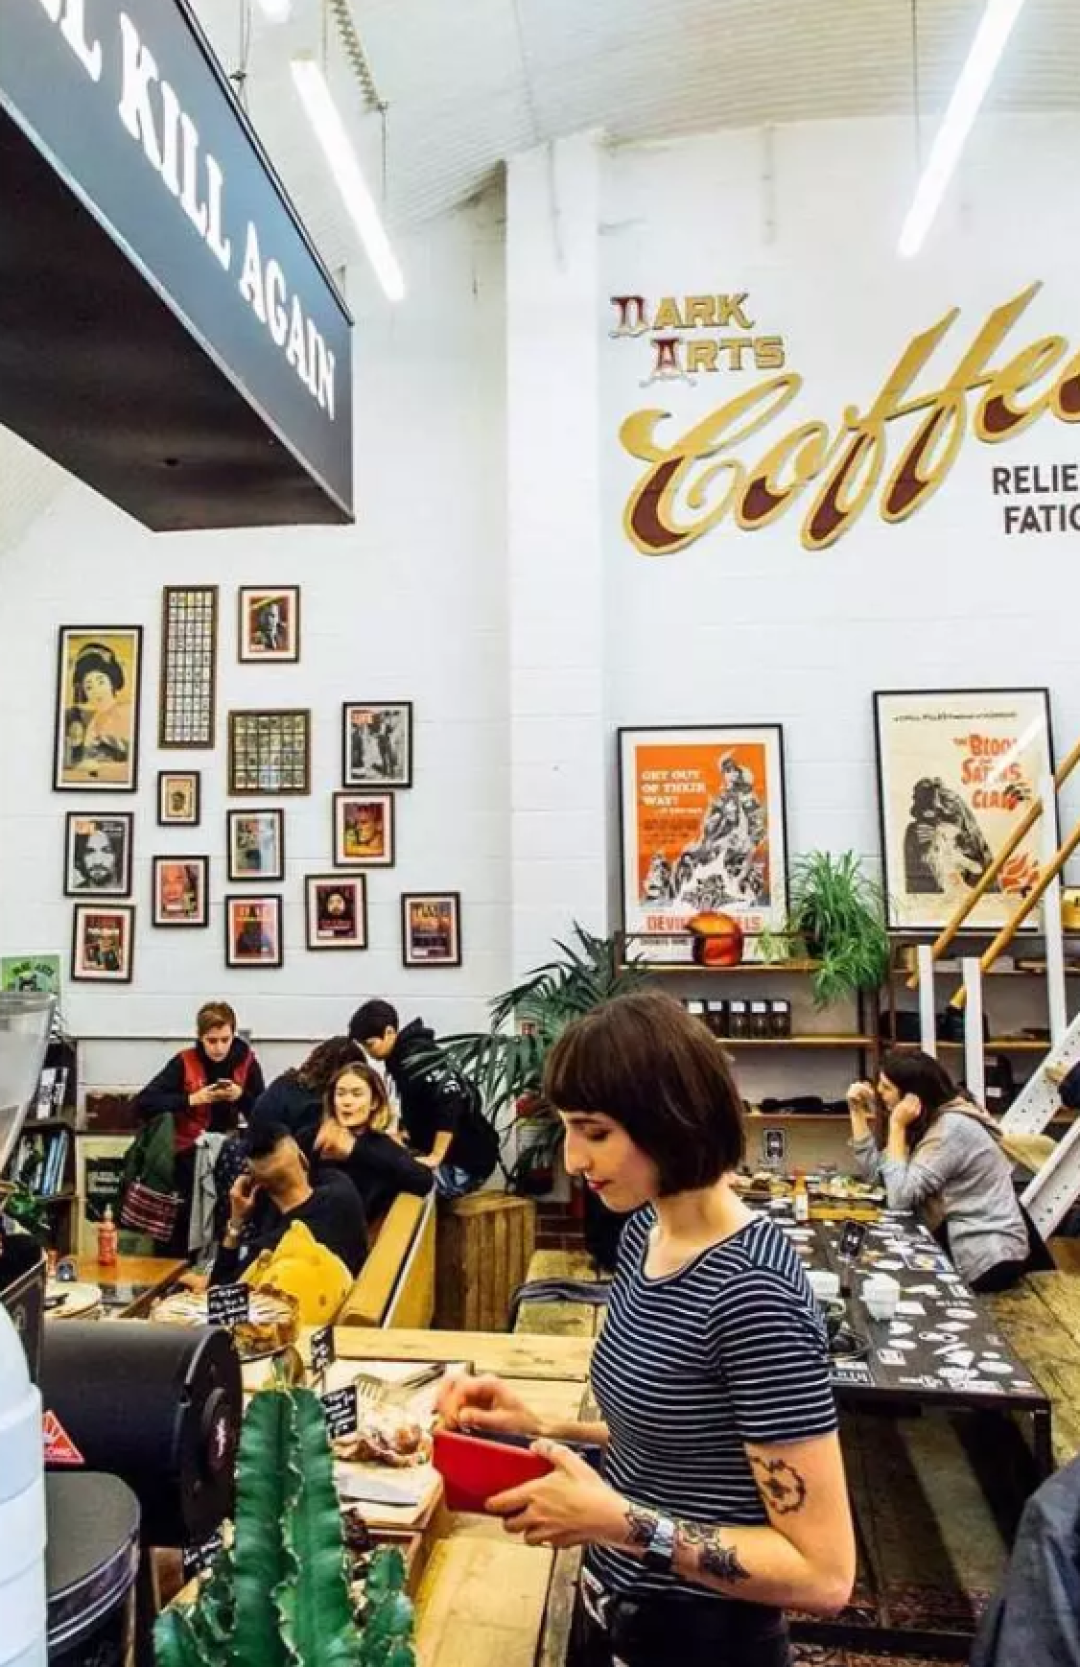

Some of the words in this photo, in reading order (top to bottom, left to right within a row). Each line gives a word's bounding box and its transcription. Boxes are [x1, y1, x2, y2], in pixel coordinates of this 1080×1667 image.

[118, 12, 231, 270] KILL
[239, 221, 336, 421] AGAIN
[609, 293, 755, 337] DARK
[640, 335, 785, 386] ARTS
[992, 463, 1079, 495] RELIE
